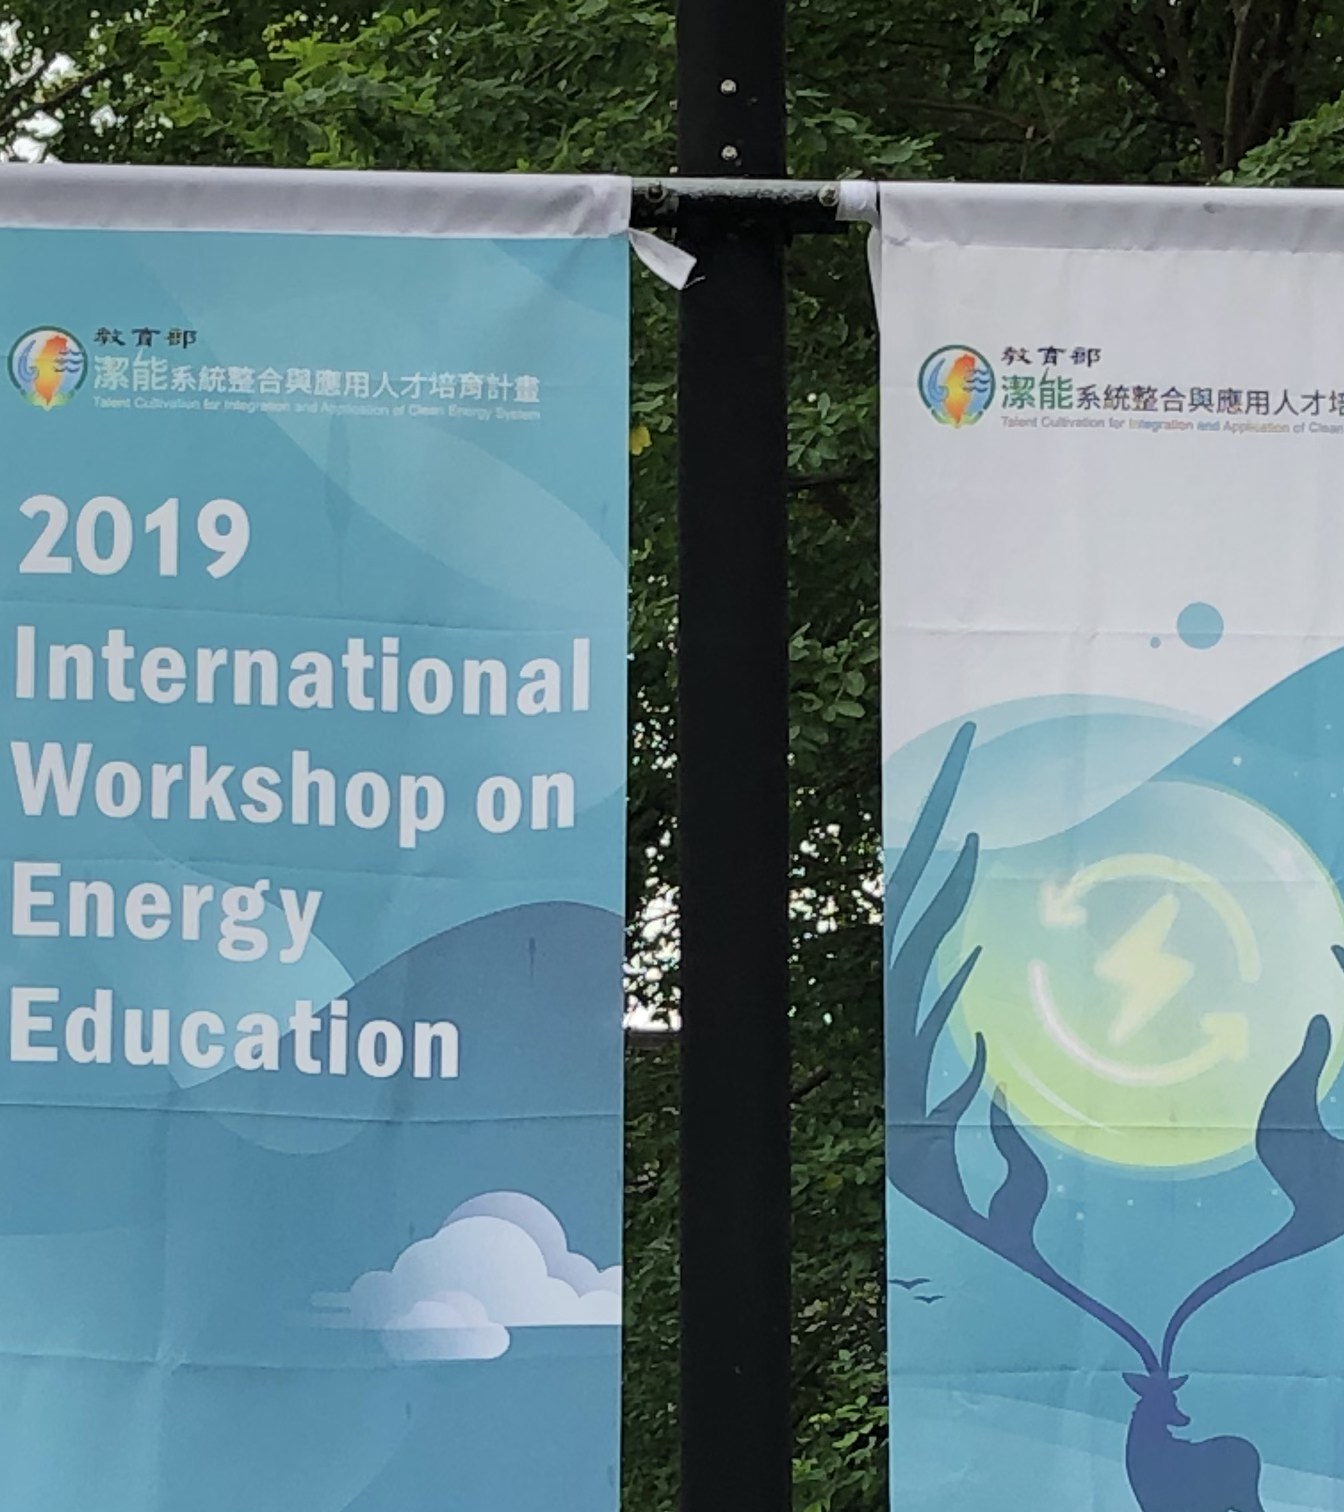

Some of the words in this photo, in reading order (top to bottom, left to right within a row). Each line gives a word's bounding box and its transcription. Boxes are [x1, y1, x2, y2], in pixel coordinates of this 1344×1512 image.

[93, 327, 198, 349] 教育部
[1001, 346, 1102, 367] 教育部
[1001, 416, 1038, 429] Talent
[1041, 416, 1105, 429] Cultivation
[1109, 416, 1125, 429] for
[1129, 418, 1194, 433] Integration
[1293, 421, 1305, 433] of
[1308, 421, 1344, 434] Clean
[18, 493, 251, 579] 2019
[14, 625, 591, 716] International
[9, 740, 446, 849] Workshop
[475, 770, 576, 834] on
[11, 861, 323, 964] Energy
[9, 986, 459, 1079] Education
